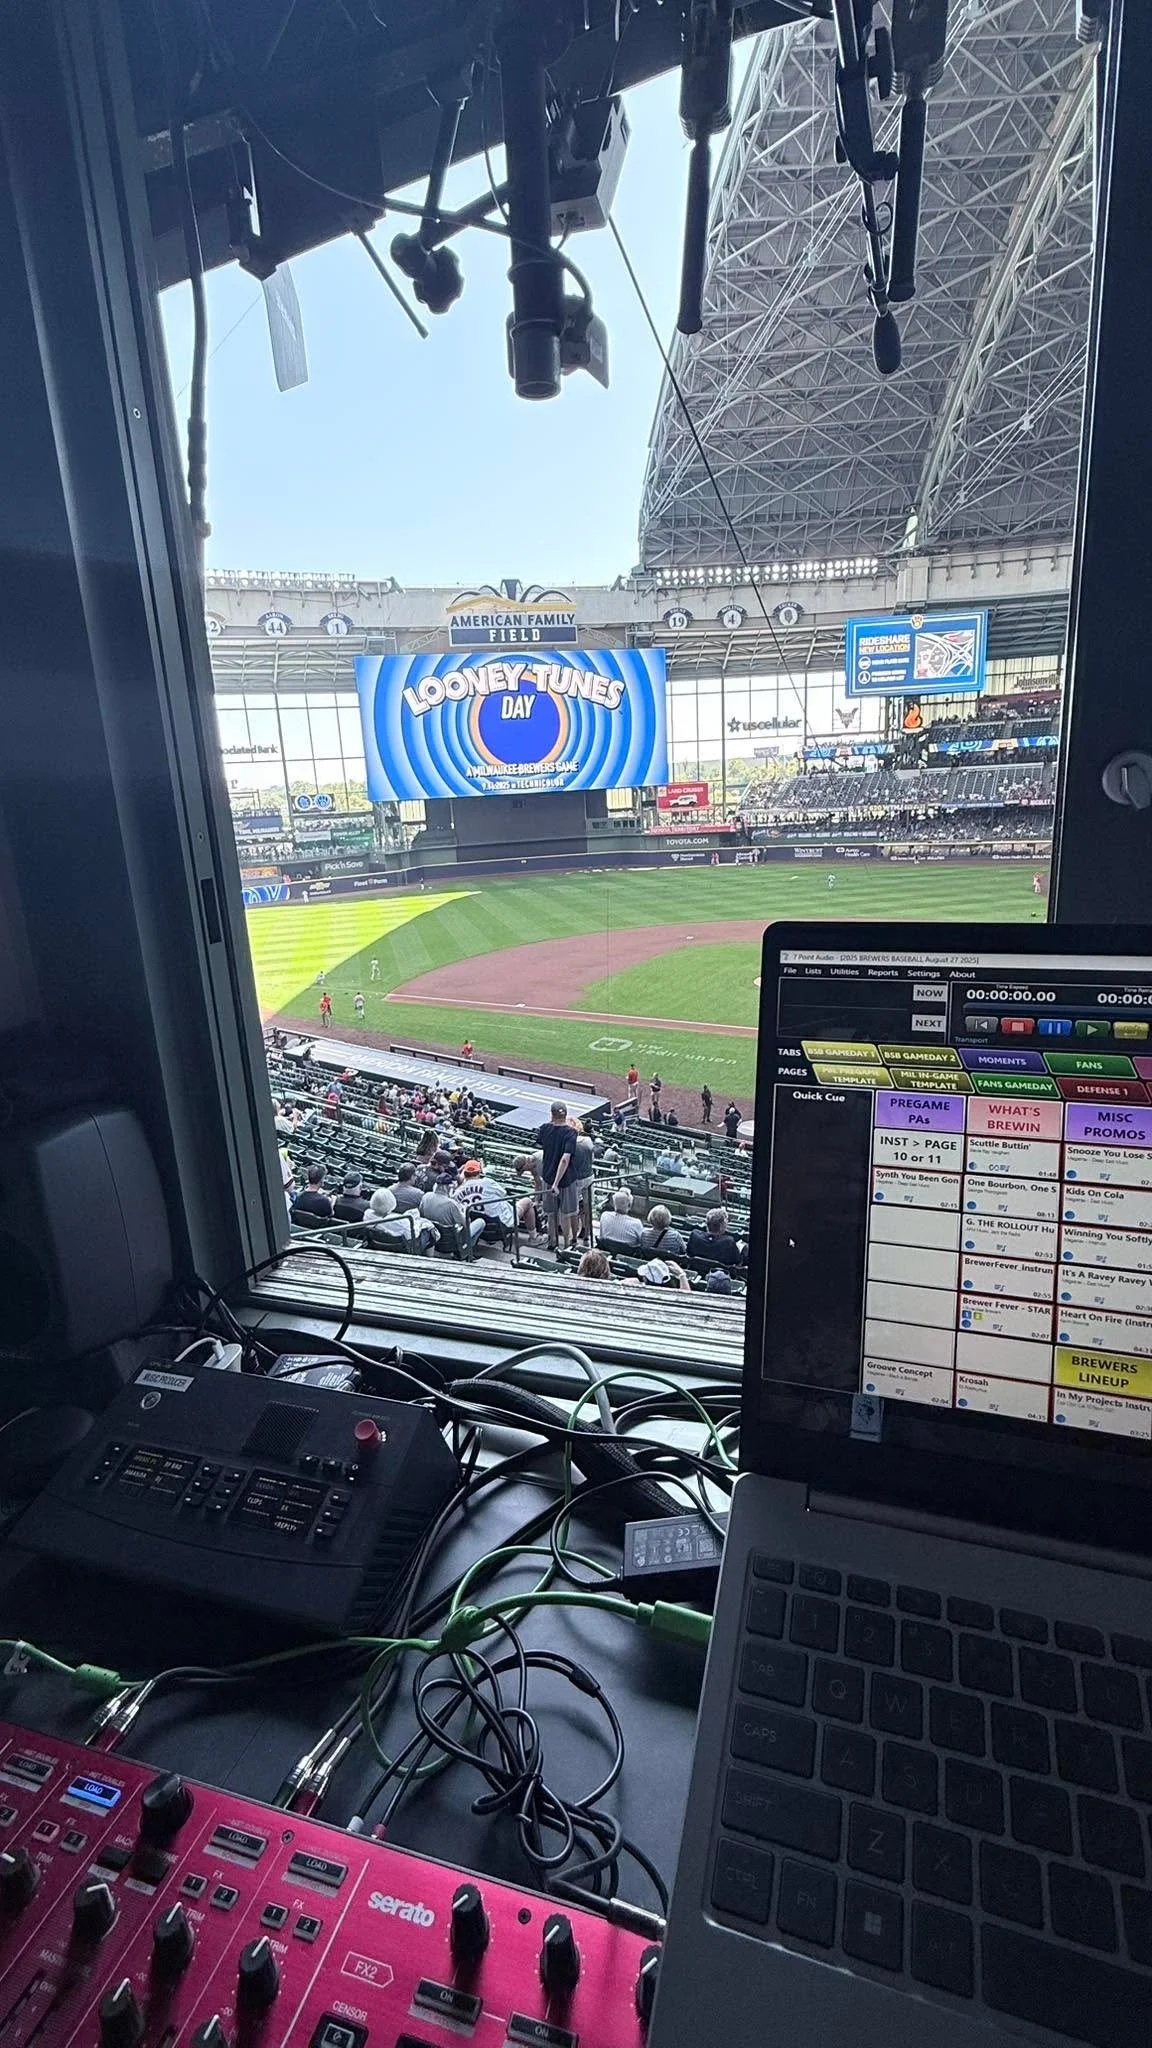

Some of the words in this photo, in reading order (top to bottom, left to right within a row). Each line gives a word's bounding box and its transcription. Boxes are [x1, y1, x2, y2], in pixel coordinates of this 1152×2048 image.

[451, 615, 522, 627] AMERICAN
[527, 613, 576, 626] FAMILY
[672, 617, 685, 628] 19
[268, 622, 284, 634] 44
[335, 623, 341, 634] 1
[489, 629, 541, 642] FIELD
[859, 634, 911, 647] RIDESHARE
[859, 645, 878, 655] NEW
[878, 643, 911, 654] LOCATION
[402, 662, 528, 717] LOONEY
[532, 663, 625, 711] TUNES
[501, 694, 537, 720] DAY
[743, 716, 802, 731] uscellular
[258, 744, 279, 754] Bank
[474, 763, 518, 777] MILWAUKEE
[519, 762, 556, 775] BREWERS
[556, 761, 580, 773] GAME
[517, 779, 565, 789] TECHNICOLOR
[666, 838, 709, 846] TOYOTA.COM
[345, 861, 364, 869] Save
[859, 954, 889, 963] BREWERS
[891, 955, 923, 963] BASEBALL
[925, 956, 949, 965] August
[805, 967, 822, 975] Lists
[830, 968, 860, 976] Utilities
[868, 969, 899, 978] Reports
[907, 969, 941, 979] Settings
[949, 970, 976, 979] About
[917, 989, 944, 997] NOW
[966, 989, 1056, 1002] 00:00:00.00
[915, 1019, 943, 1028] NEXT
[778, 1048, 801, 1057] TABS
[902, 1053, 949, 1062] GAMEDAY
[950, 1054, 956, 1062] 2
[685, 1054, 737, 1065] union
[979, 1056, 1027, 1065] MOMENTS
[1076, 1061, 1103, 1070] FANS
[778, 1067, 808, 1076] PAGES
[901, 1071, 917, 1079] MIL
[919, 1072, 959, 1081] IN-GAME
[832, 1076, 877, 1085] TEMPLATE
[910, 1081, 957, 1090] TEMPLATE
[978, 1080, 1003, 1089] FANS
[1005, 1081, 1053, 1091] GAMEDAY
[470, 1080, 520, 1098] FIELD
[1077, 1085, 1120, 1095] DEFENSE
[1123, 1087, 1129, 1095] 1
[792, 1091, 823, 1101] Quick
[825, 1092, 846, 1102] Cue
[890, 1098, 951, 1111] PREGAME
[988, 1104, 1041, 1117] WHAT'S
[908, 1114, 930, 1125] PAs
[1097, 1111, 1134, 1123] MISC
[987, 1120, 1041, 1133] BREWIN
[1084, 1126, 1147, 1140] PROMOS
[880, 1135, 909, 1146] INST
[913, 1139, 920, 1147] >
[924, 1139, 957, 1150] PAGE
[970, 1139, 1000, 1148] Scuttle
[1001, 1141, 1031, 1150] Buttin'
[893, 1152, 907, 1161] 10
[911, 1154, 925, 1163] or
[928, 1155, 941, 1164] 11
[1067, 1146, 1101, 1157] Snooze
[1103, 1149, 1121, 1158] You
[1123, 1151, 1145, 1160] Lose
[876, 1171, 899, 1181] Synth
[901, 1172, 916, 1181] You
[918, 1174, 939, 1183] Been
[940, 1175, 959, 1184] Gon
[968, 1178, 985, 1187] One
[1030, 1184, 1049, 1193] One
[1051, 1185, 1057, 1194] S
[1066, 1187, 1085, 1196] Kids
[1087, 1189, 1101, 1198] On
[1103, 1191, 1125, 1200] Cola
[977, 1219, 995, 1228] THE
[997, 1221, 1039, 1233] ROLLOUT
[1041, 1225, 1055, 1234] Hu
[1064, 1228, 1103, 1241] Winning
[1106, 1233, 1123, 1241] You
[1125, 1234, 1152, 1246] Softly
[1062, 1269, 1076, 1278] It's
[1078, 1270, 1086, 1278] A
[1088, 1272, 1116, 1283] Ravey
[1118, 1275, 1147, 1287] Ravey
[962, 1297, 993, 1307] Brewer
[995, 1300, 1019, 1311] Fever
[1027, 1305, 1051, 1315] STAR
[1061, 1310, 1087, 1320] Heart
[1088, 1313, 1103, 1322] On
[1105, 1315, 1122, 1325] Fire
[866, 1361, 897, 1373] Groove
[898, 1365, 933, 1378] Concept
[1071, 1355, 1138, 1374] BREWERS
[959, 1375, 989, 1387] Krosah
[1079, 1372, 1130, 1389] LINEUP
[1056, 1391, 1067, 1399] In
[1068, 1393, 1083, 1403] My
[1086, 1395, 1123, 1409] Projects
[247, 1496, 264, 1506] CLIPS
[830, 1679, 848, 1700] Q
[742, 1724, 778, 1744] CAPS
[84, 1781, 104, 1795] LOAD
[229, 1830, 248, 1844] LOAD
[868, 1829, 884, 1855] Z
[306, 1859, 328, 1872] LOAD
[213, 1870, 224, 1880] FX
[192, 1878, 197, 1888] 1
[221, 1889, 228, 1899] 2
[293, 1899, 305, 1910] FX
[367, 1890, 436, 1928] serato
[187, 1908, 206, 1921] TRIM
[272, 1908, 277, 1918] 1
[304, 1920, 310, 1930] 2
[269, 1938, 289, 1954] TRIM
[354, 1961, 379, 1980] FX2
[440, 1990, 454, 2002] ON
[332, 2000, 369, 2023] CENSOR
[535, 2024, 550, 2038] ON
